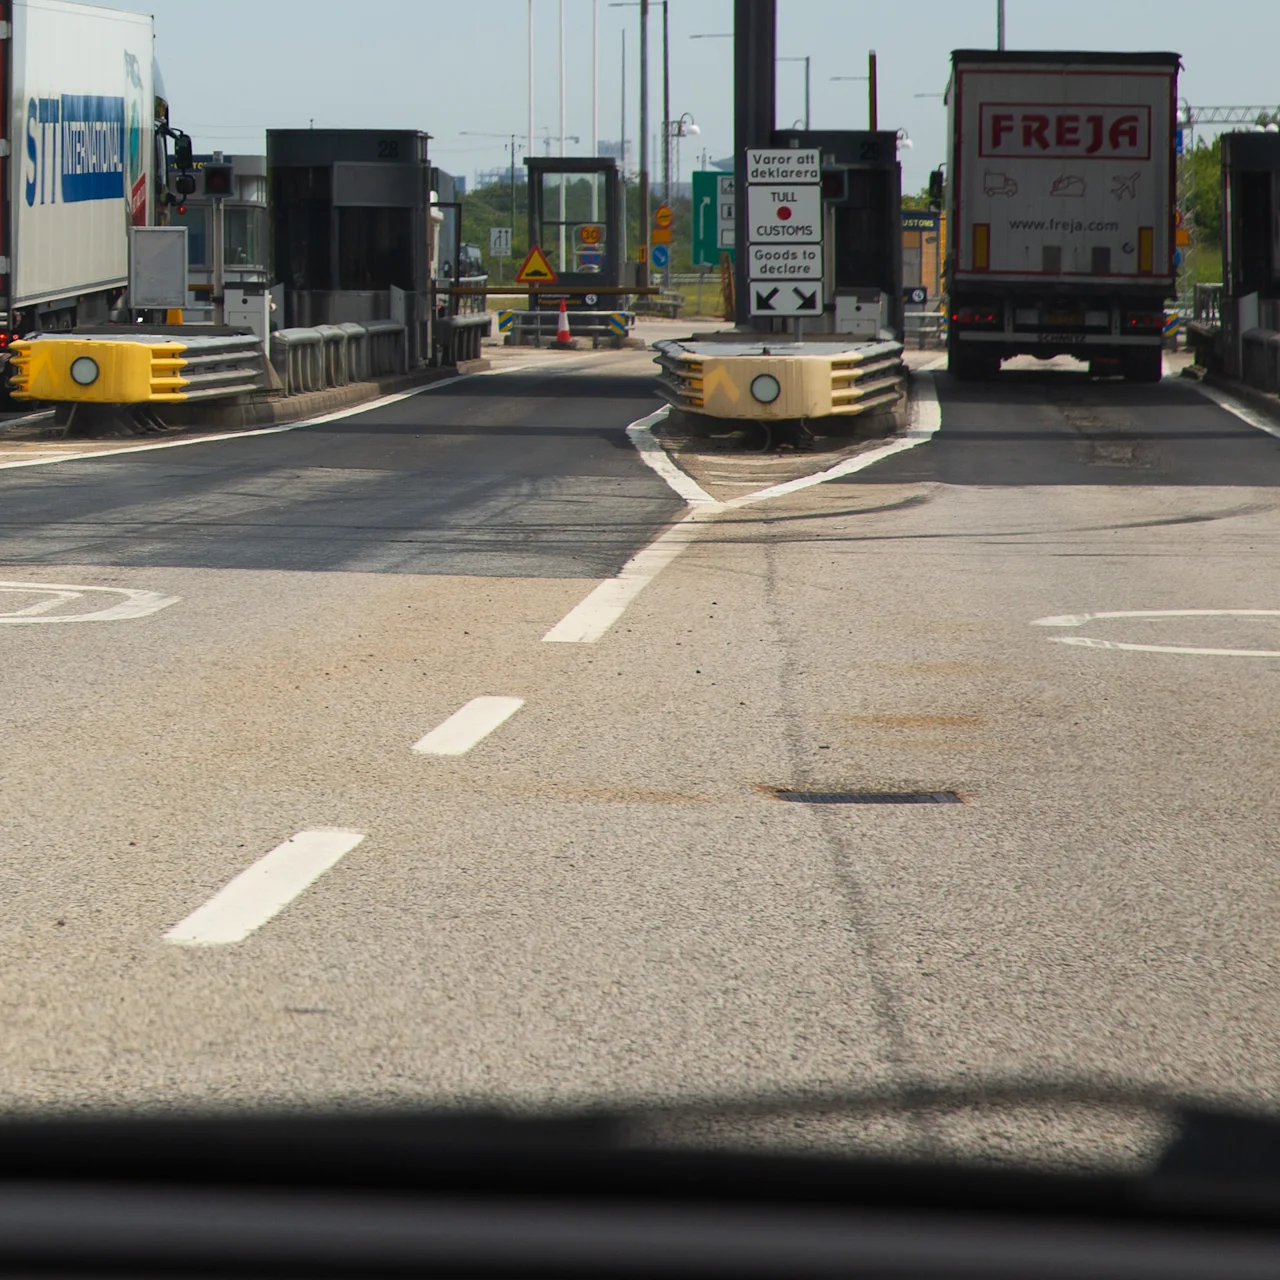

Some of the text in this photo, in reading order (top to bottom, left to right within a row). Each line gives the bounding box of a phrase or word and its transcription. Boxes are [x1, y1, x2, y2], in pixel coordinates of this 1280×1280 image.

[991, 114, 1140, 155] FREJA
[26, 97, 60, 207] STT
[63, 121, 123, 175] INTERNATIONAL
[378, 140, 399, 158] 28
[753, 154, 815, 165] Varor att
[751, 167, 818, 178] deklarera
[770, 192, 797, 202] TULL
[902, 219, 934, 227] USTOMS
[1009, 218, 1119, 234] www.freja.com
[756, 225, 813, 236] CUSTOMS
[754, 249, 816, 261] Goods to
[759, 263, 811, 274] declare
